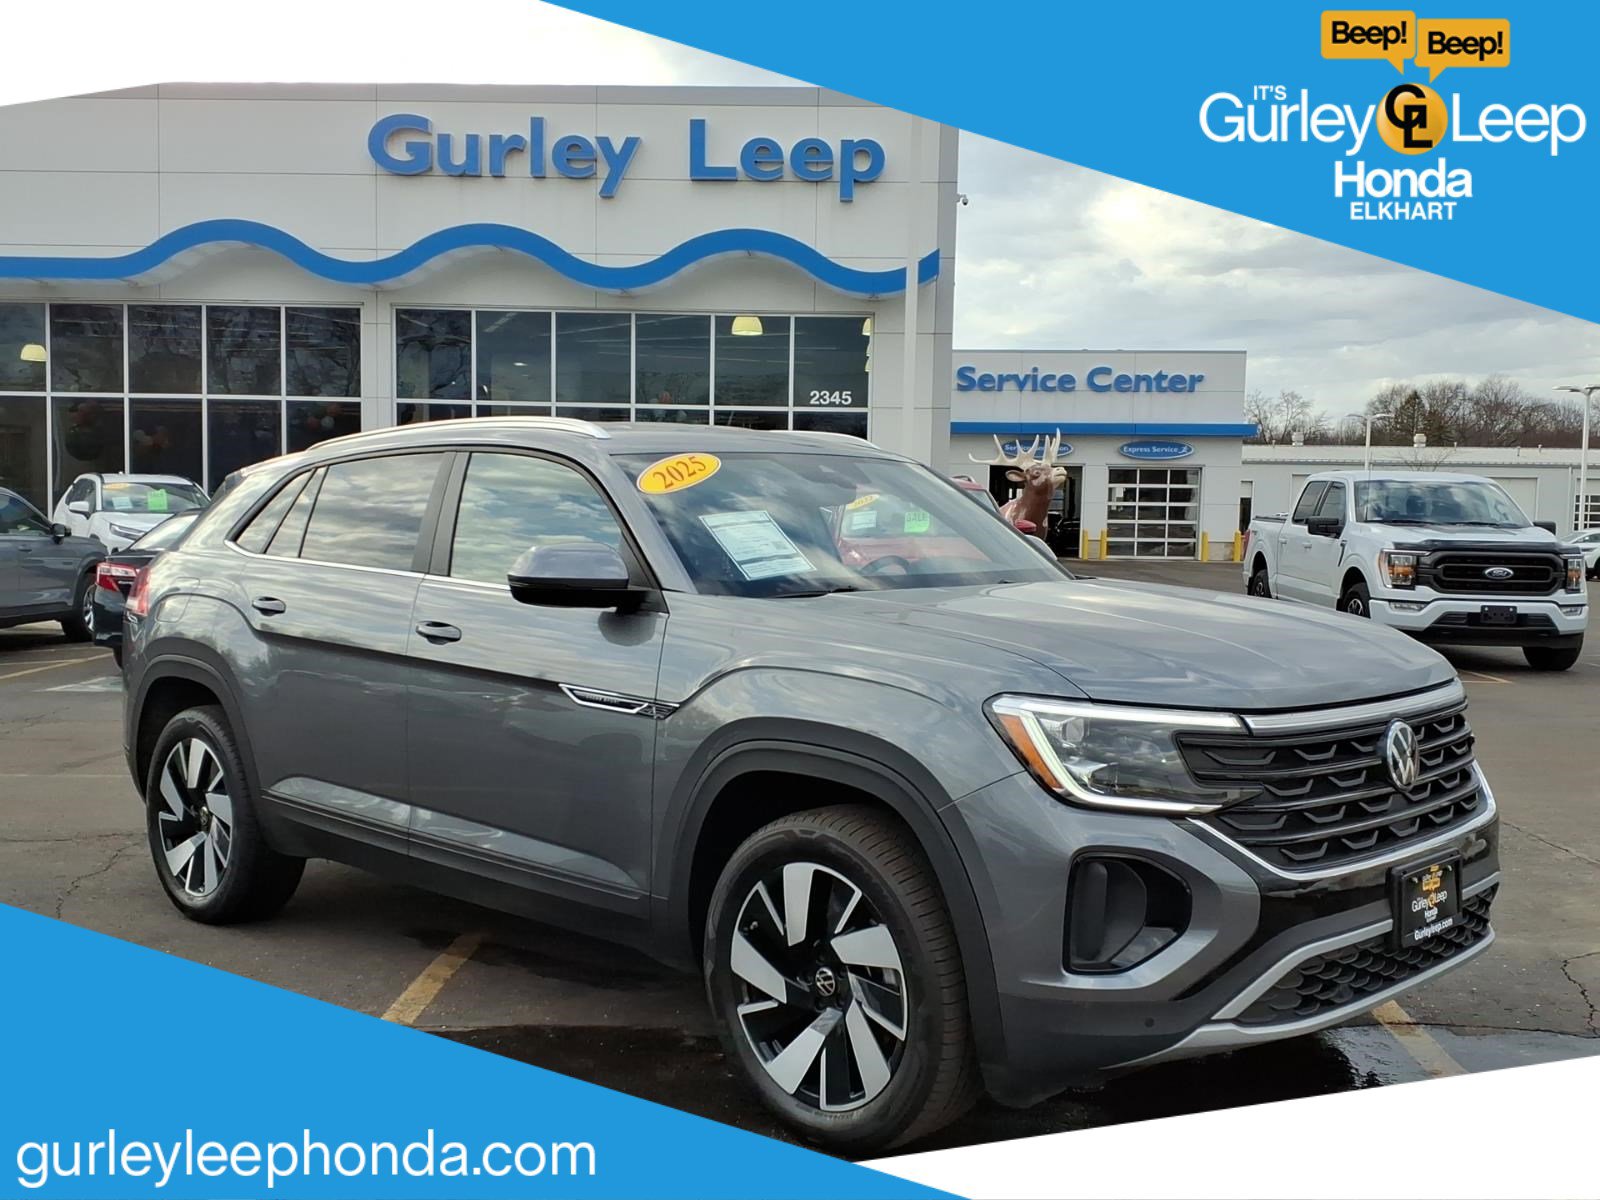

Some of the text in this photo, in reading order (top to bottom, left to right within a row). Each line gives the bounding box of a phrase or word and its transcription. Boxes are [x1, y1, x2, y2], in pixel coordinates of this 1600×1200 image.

[367, 113, 886, 202] Gurley Leep
[956, 365, 1204, 393] Service Center
[809, 390, 852, 406] 2345
[1152, 445, 1178, 453] Service
[652, 455, 708, 489] 2025
